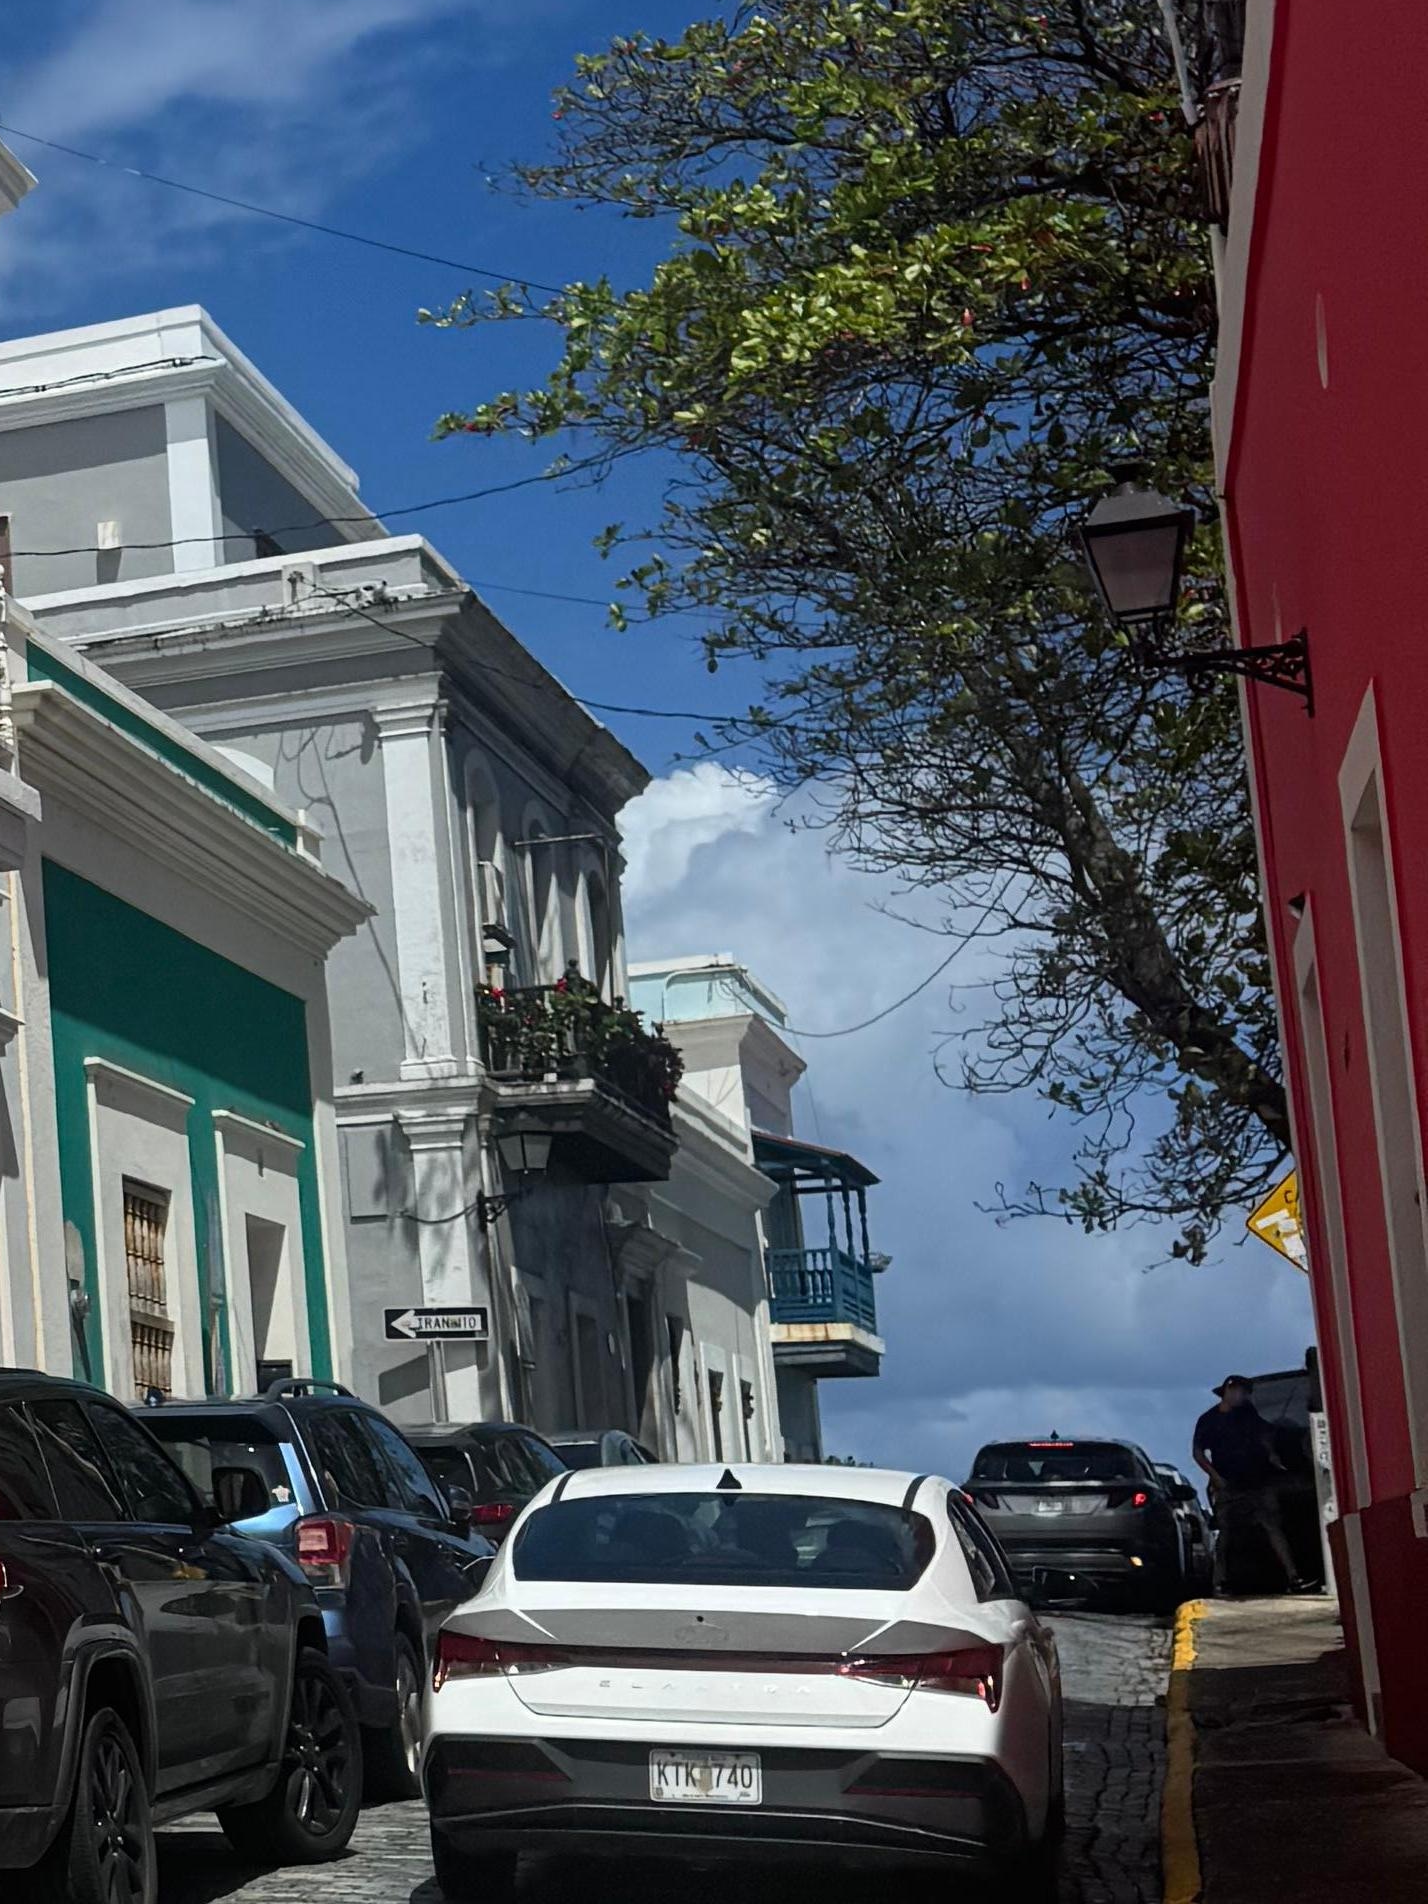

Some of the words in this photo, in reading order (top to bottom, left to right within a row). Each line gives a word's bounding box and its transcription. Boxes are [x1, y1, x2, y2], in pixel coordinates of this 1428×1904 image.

[599, 1679, 812, 1696] ELATRA
[657, 1760, 697, 1788] KTK
[712, 1763, 752, 1789] 740
